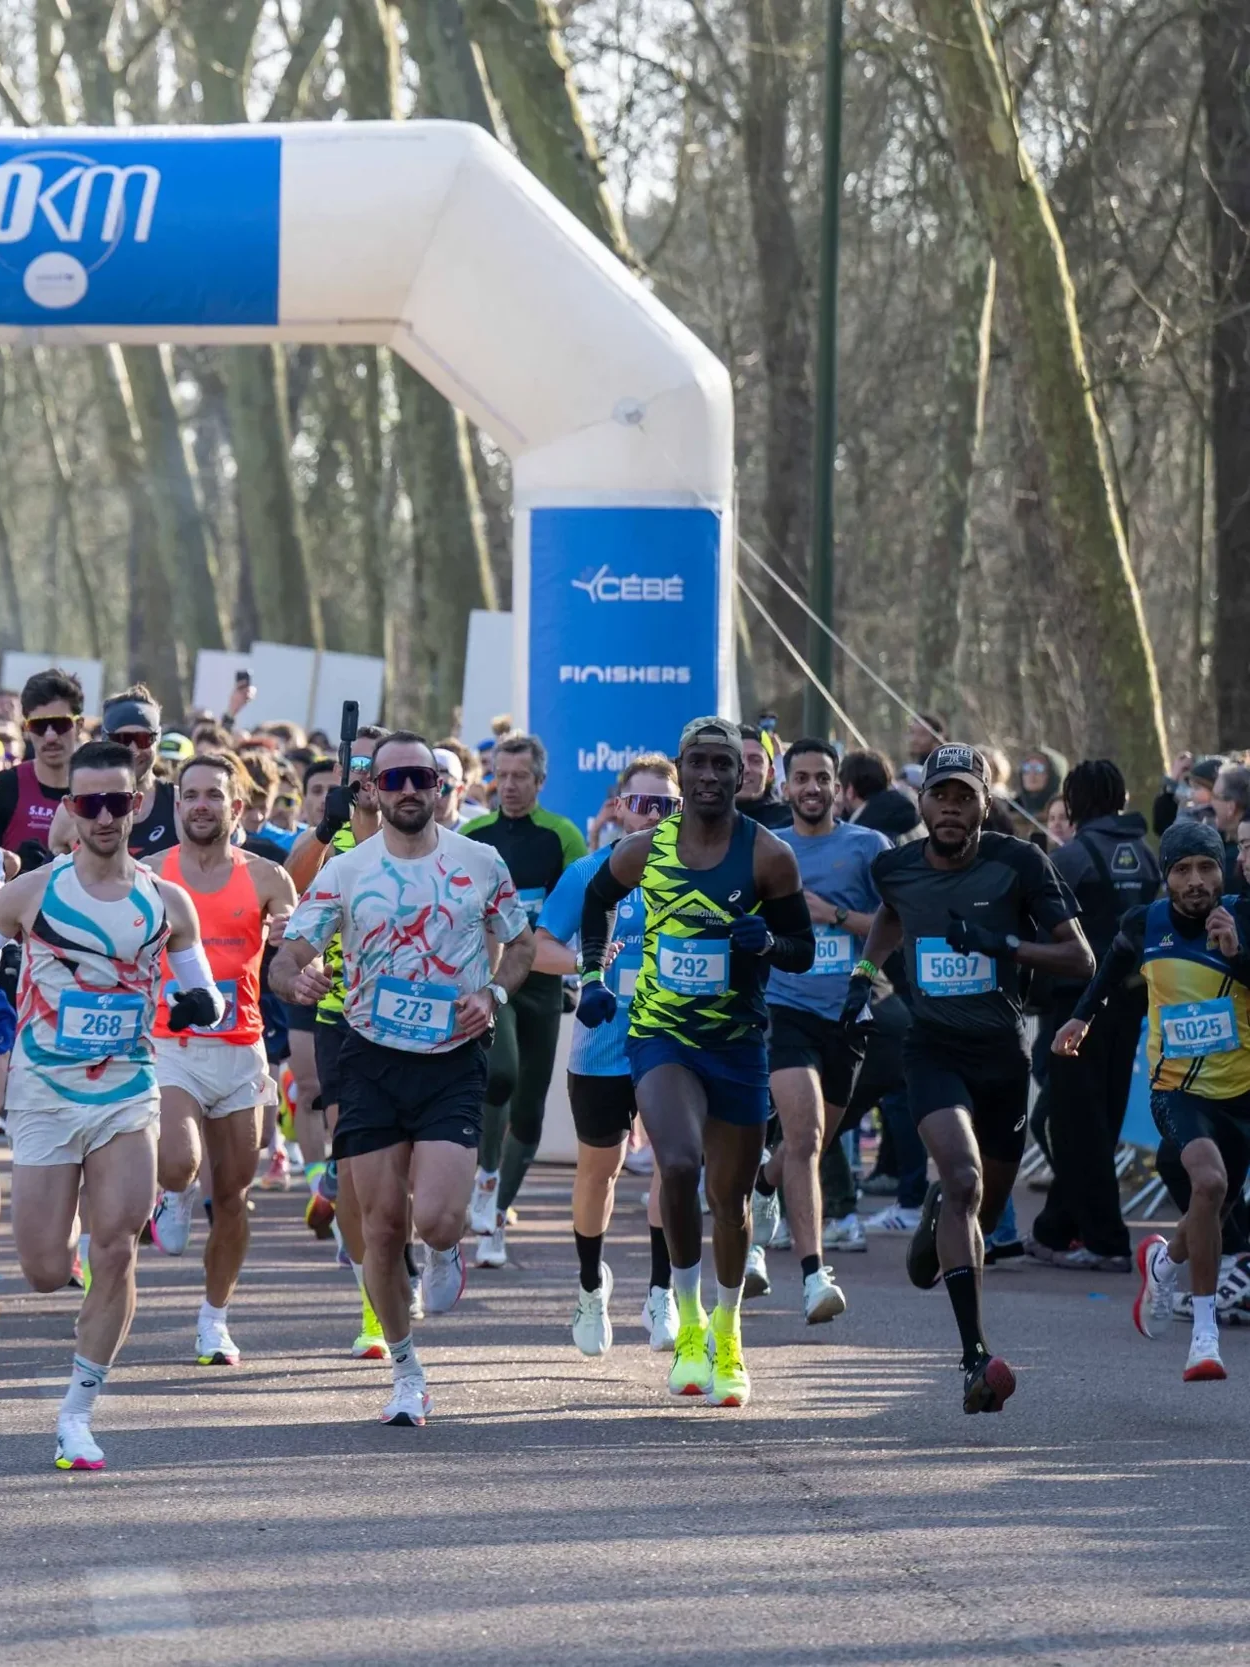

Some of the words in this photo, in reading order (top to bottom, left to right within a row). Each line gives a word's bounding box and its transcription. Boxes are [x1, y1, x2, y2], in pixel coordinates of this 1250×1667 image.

[939, 748, 971, 758] YANKEES
[817, 940, 838, 958] 60
[672, 956, 708, 978] 292
[930, 956, 979, 978] 5697
[393, 998, 433, 1023] 273
[81, 1013, 122, 1037] 268
[1174, 1018, 1223, 1041] 6025
